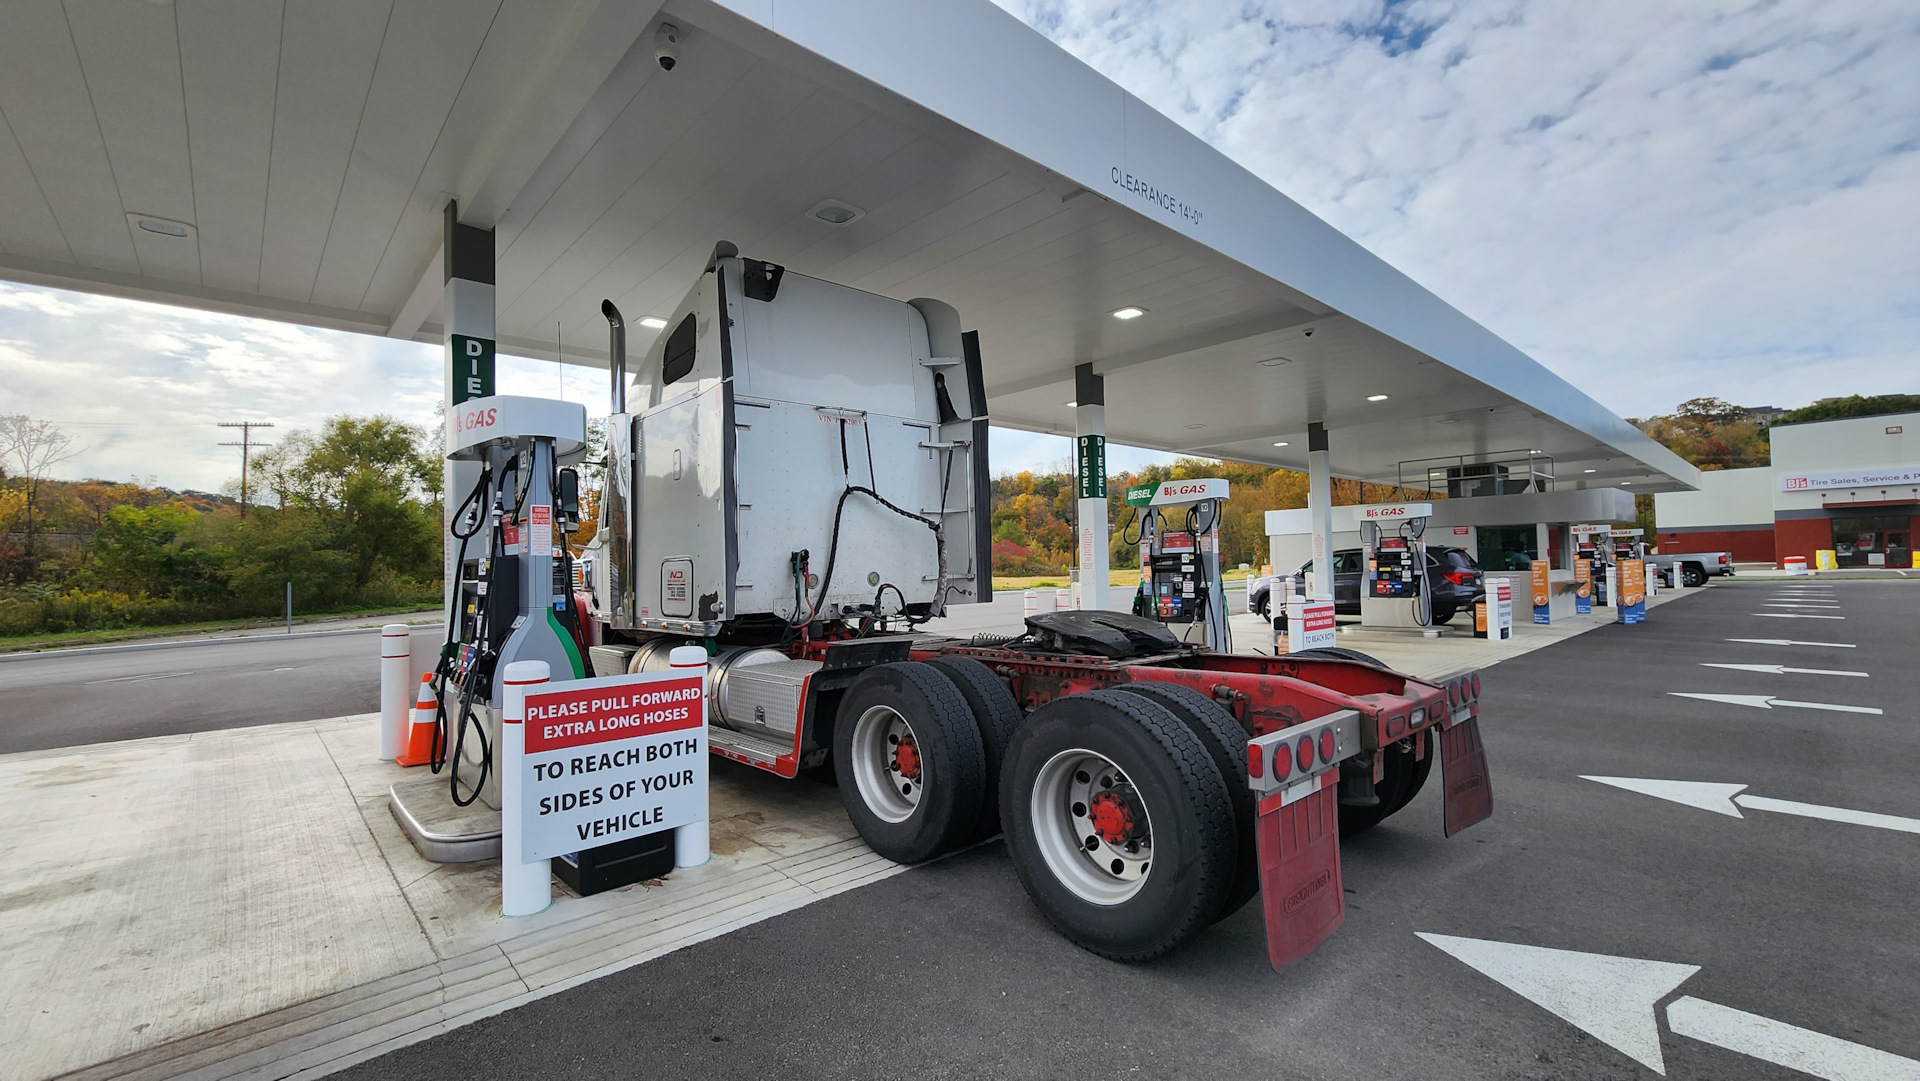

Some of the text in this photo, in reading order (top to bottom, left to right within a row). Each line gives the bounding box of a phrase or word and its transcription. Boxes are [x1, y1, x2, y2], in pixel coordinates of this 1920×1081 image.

[1111, 167, 1176, 214] CLEARANCE
[466, 339, 483, 400] DIE
[465, 408, 498, 430] GAS
[818, 415, 832, 423] VIN
[1081, 437, 1089, 497] DIESEL
[1128, 489, 1152, 501] DIESEL
[1164, 485, 1206, 496] BJ's GAS
[1367, 507, 1405, 517] BJ's GAS
[1312, 634, 1324, 642] REACH
[527, 688, 701, 721] PLEASE PULL FORWARD
[543, 707, 689, 740] EXTRA LONG HOSES
[533, 738, 698, 782] TO REACH BOTH
[539, 769, 694, 816] SIDES OF YOUR
[577, 806, 664, 841] VEHICLE
